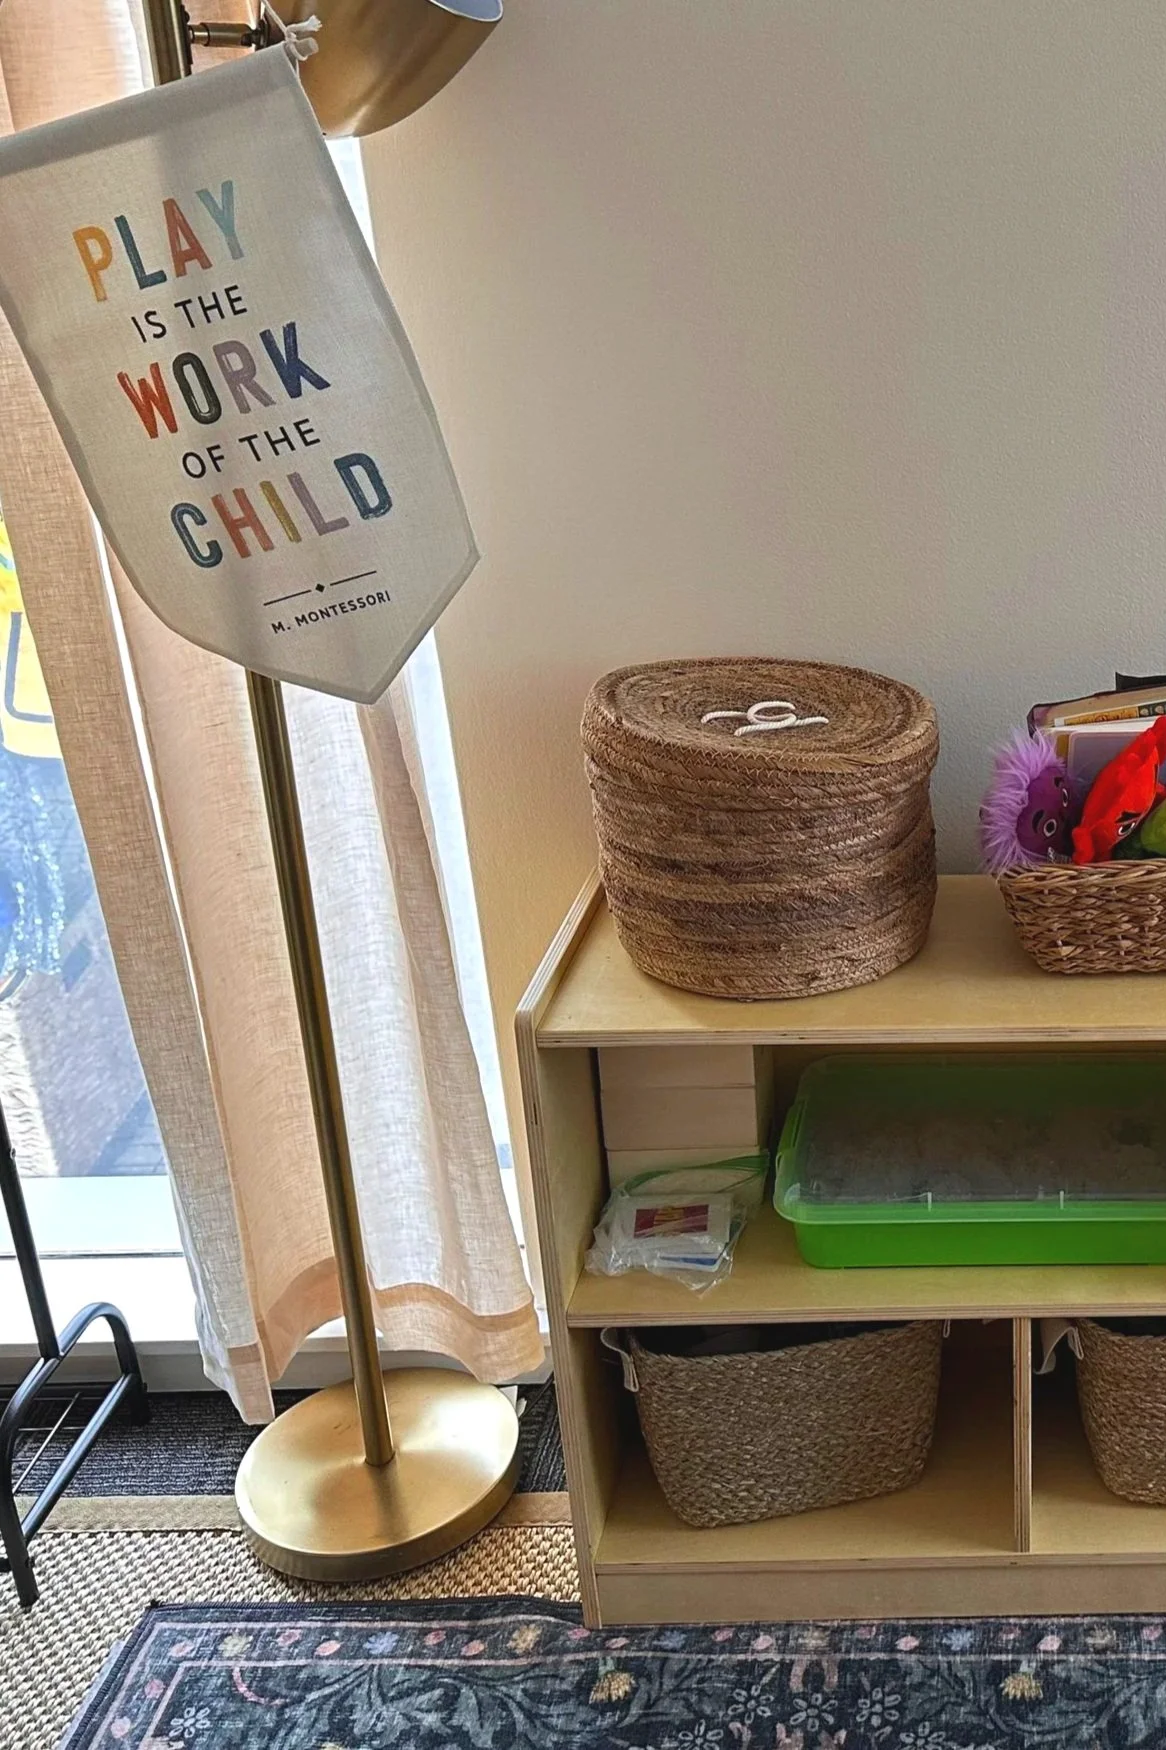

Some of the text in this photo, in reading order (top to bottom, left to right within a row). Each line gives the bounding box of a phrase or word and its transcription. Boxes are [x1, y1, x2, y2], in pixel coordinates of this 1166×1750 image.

[72, 179, 245, 302] PLAY
[131, 285, 248, 343] IS THE
[116, 321, 331, 439] WORK
[182, 418, 321, 479] OF THE
[170, 452, 393, 569] CHILD
[271, 590, 391, 634] M. MONTESSORI
